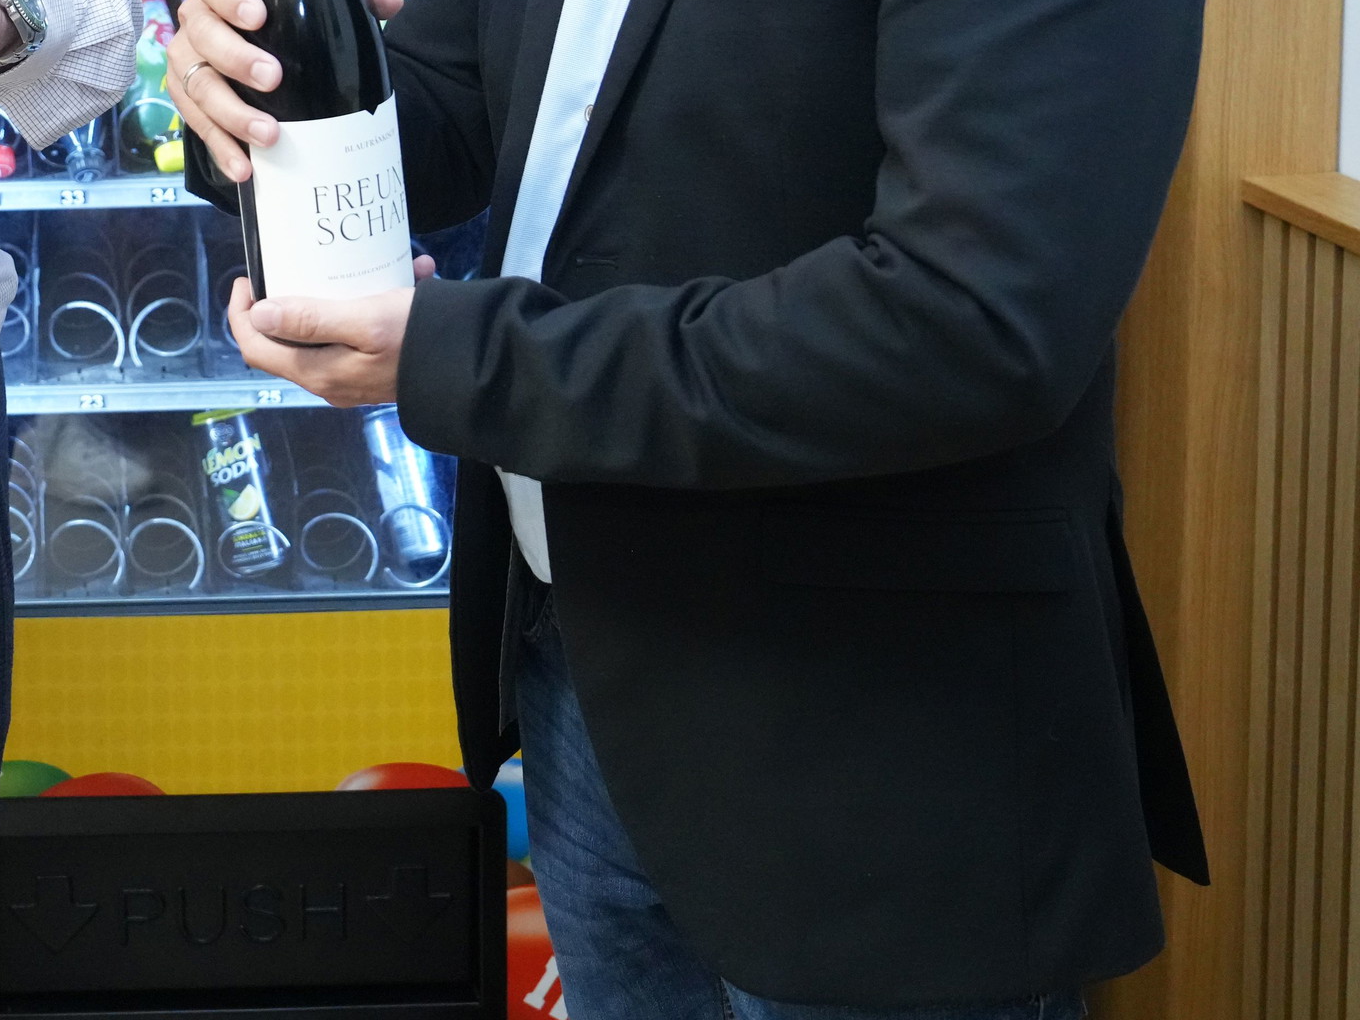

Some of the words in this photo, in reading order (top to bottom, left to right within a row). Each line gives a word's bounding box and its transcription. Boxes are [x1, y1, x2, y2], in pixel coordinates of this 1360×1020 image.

[60, 189, 86, 205] 33
[151, 187, 177, 203] 34
[80, 394, 105, 409] 23
[256, 389, 282, 404] 25
[201, 432, 262, 476] LEMON
[210, 456, 259, 488] SODA
[118, 882, 349, 947] PUSH
